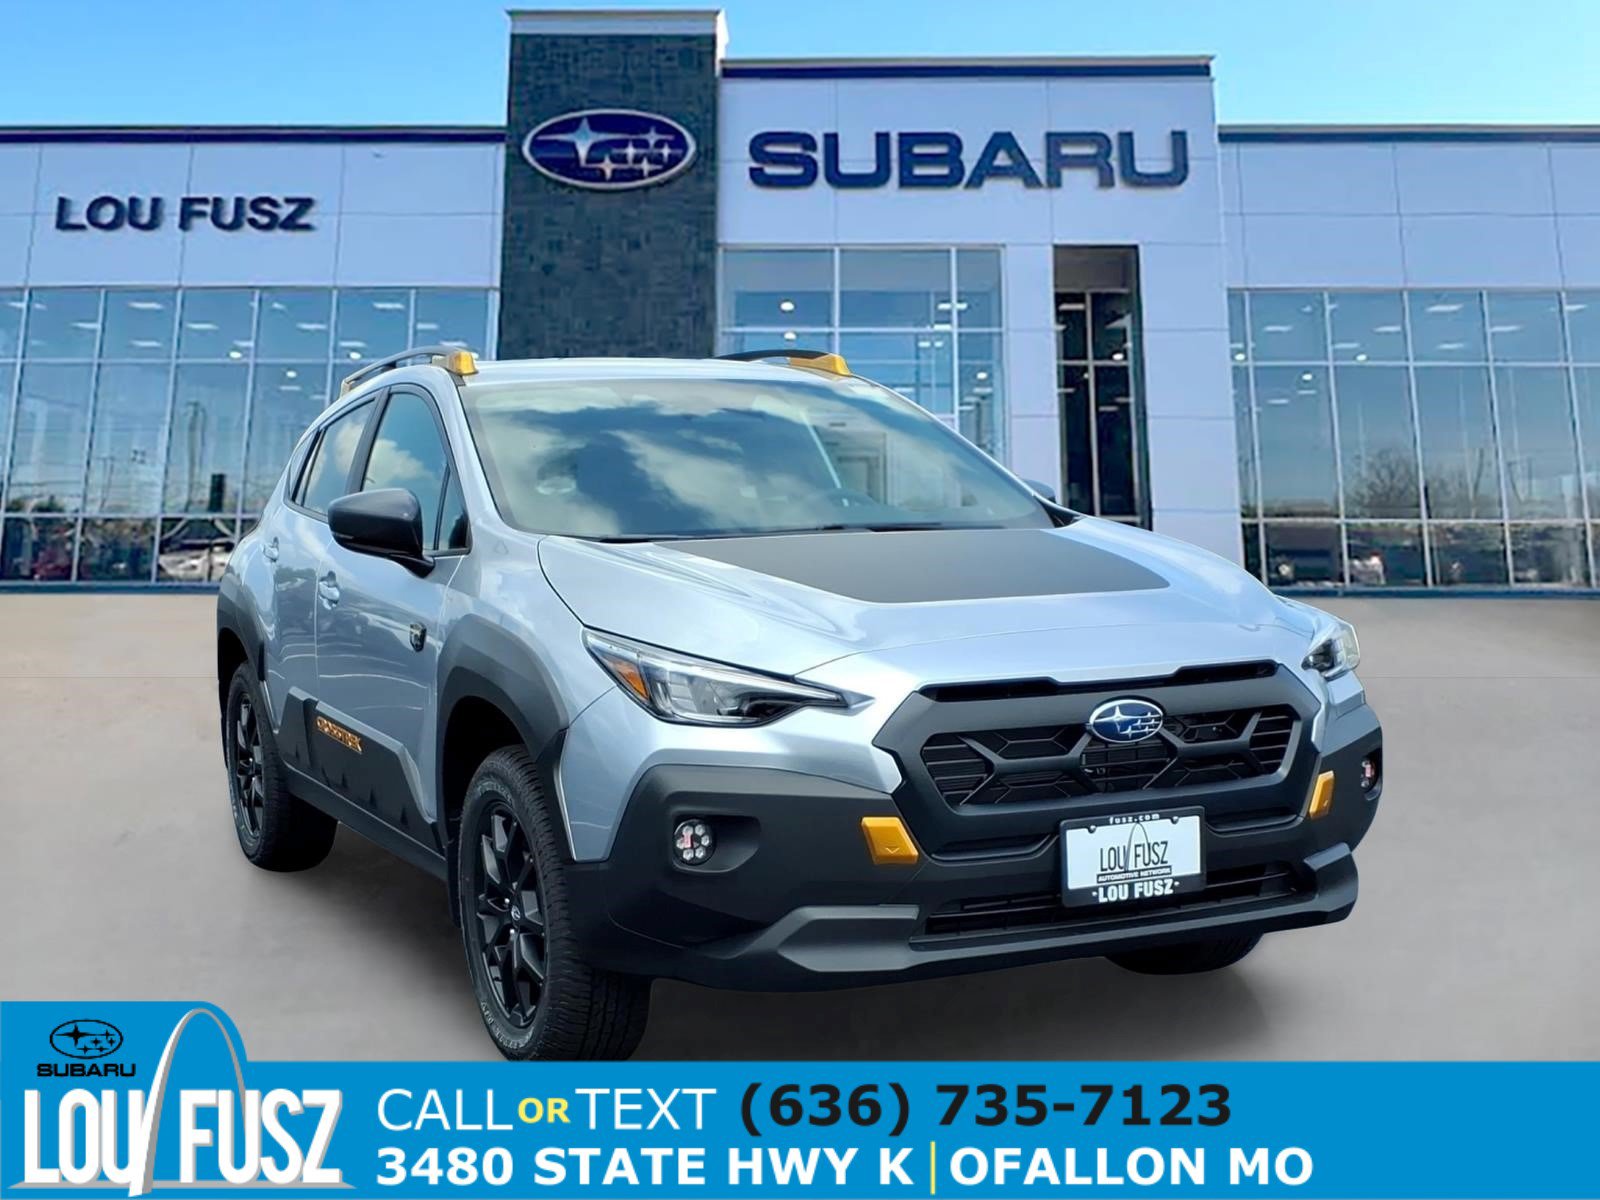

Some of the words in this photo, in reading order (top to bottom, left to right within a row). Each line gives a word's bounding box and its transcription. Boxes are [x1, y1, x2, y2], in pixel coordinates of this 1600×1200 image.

[749, 130, 1189, 190] SUBARU
[56, 196, 162, 231] LOU
[179, 196, 315, 232] FUSZ
[1109, 813, 1161, 825] fusz.com
[1100, 845, 1127, 872] LOU
[1134, 840, 1169, 868] FUSZ
[1097, 870, 1139, 882] AUTOMOTIVE
[1139, 866, 1172, 878] NETWORK
[1098, 883, 1129, 903] LOU
[1134, 878, 1174, 898] FUSZ
